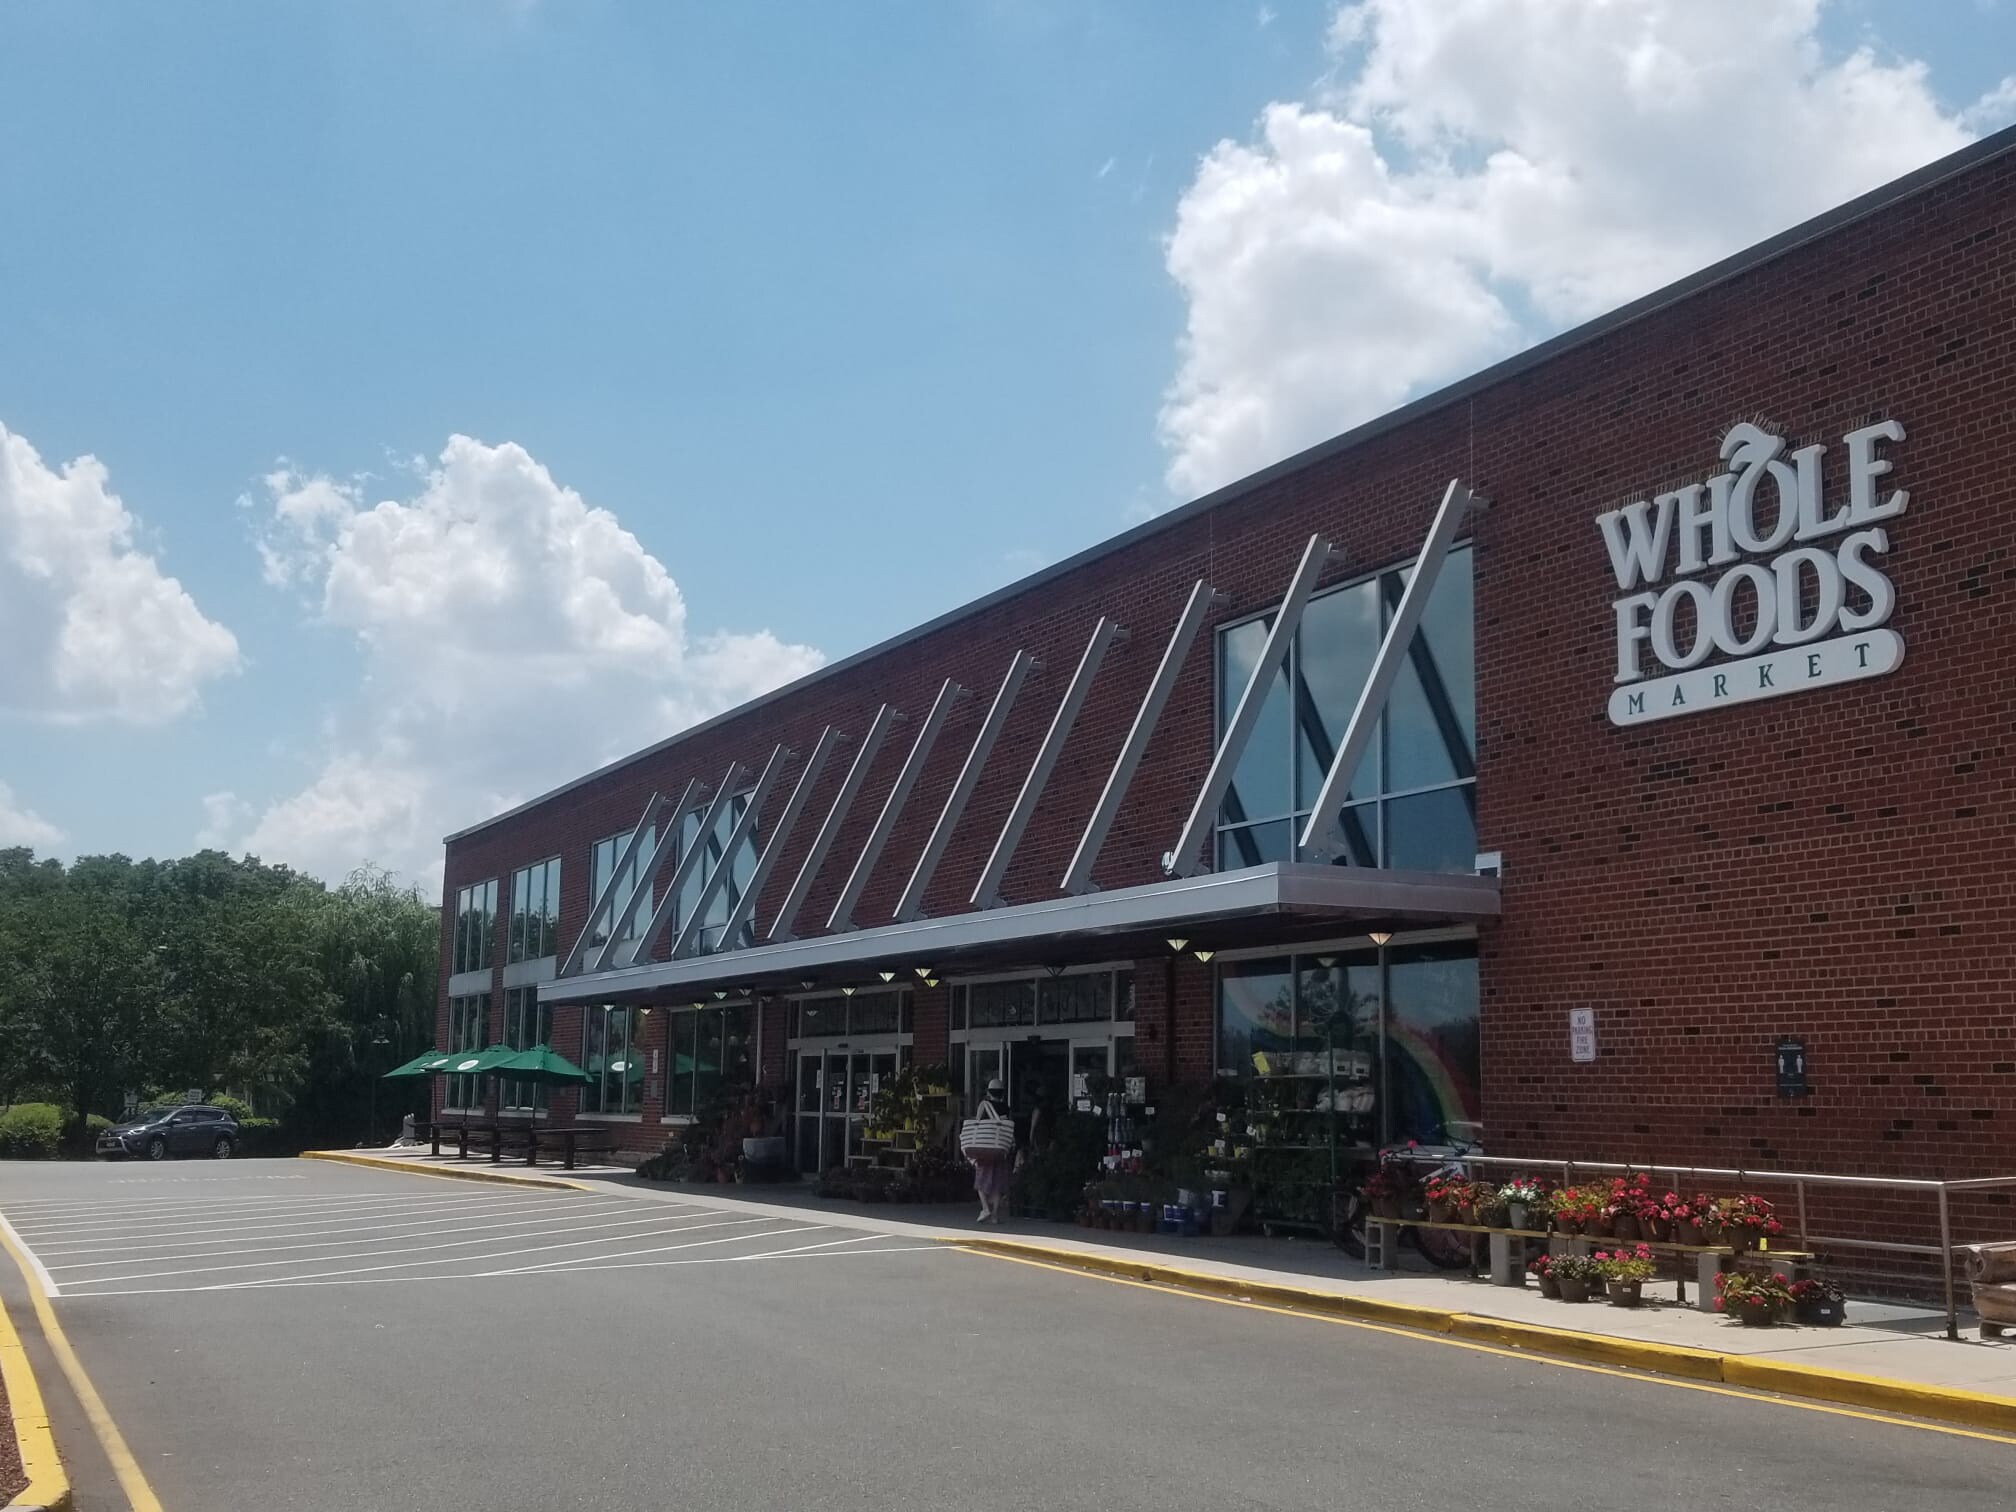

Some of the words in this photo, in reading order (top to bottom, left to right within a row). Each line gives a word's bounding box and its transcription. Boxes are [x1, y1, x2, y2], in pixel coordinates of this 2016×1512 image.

[1596, 420, 1910, 590] WHOLE
[1612, 528, 1896, 683] FOODS
[1628, 643, 1870, 715] MARKET
[1577, 1015, 1586, 1025] NO
